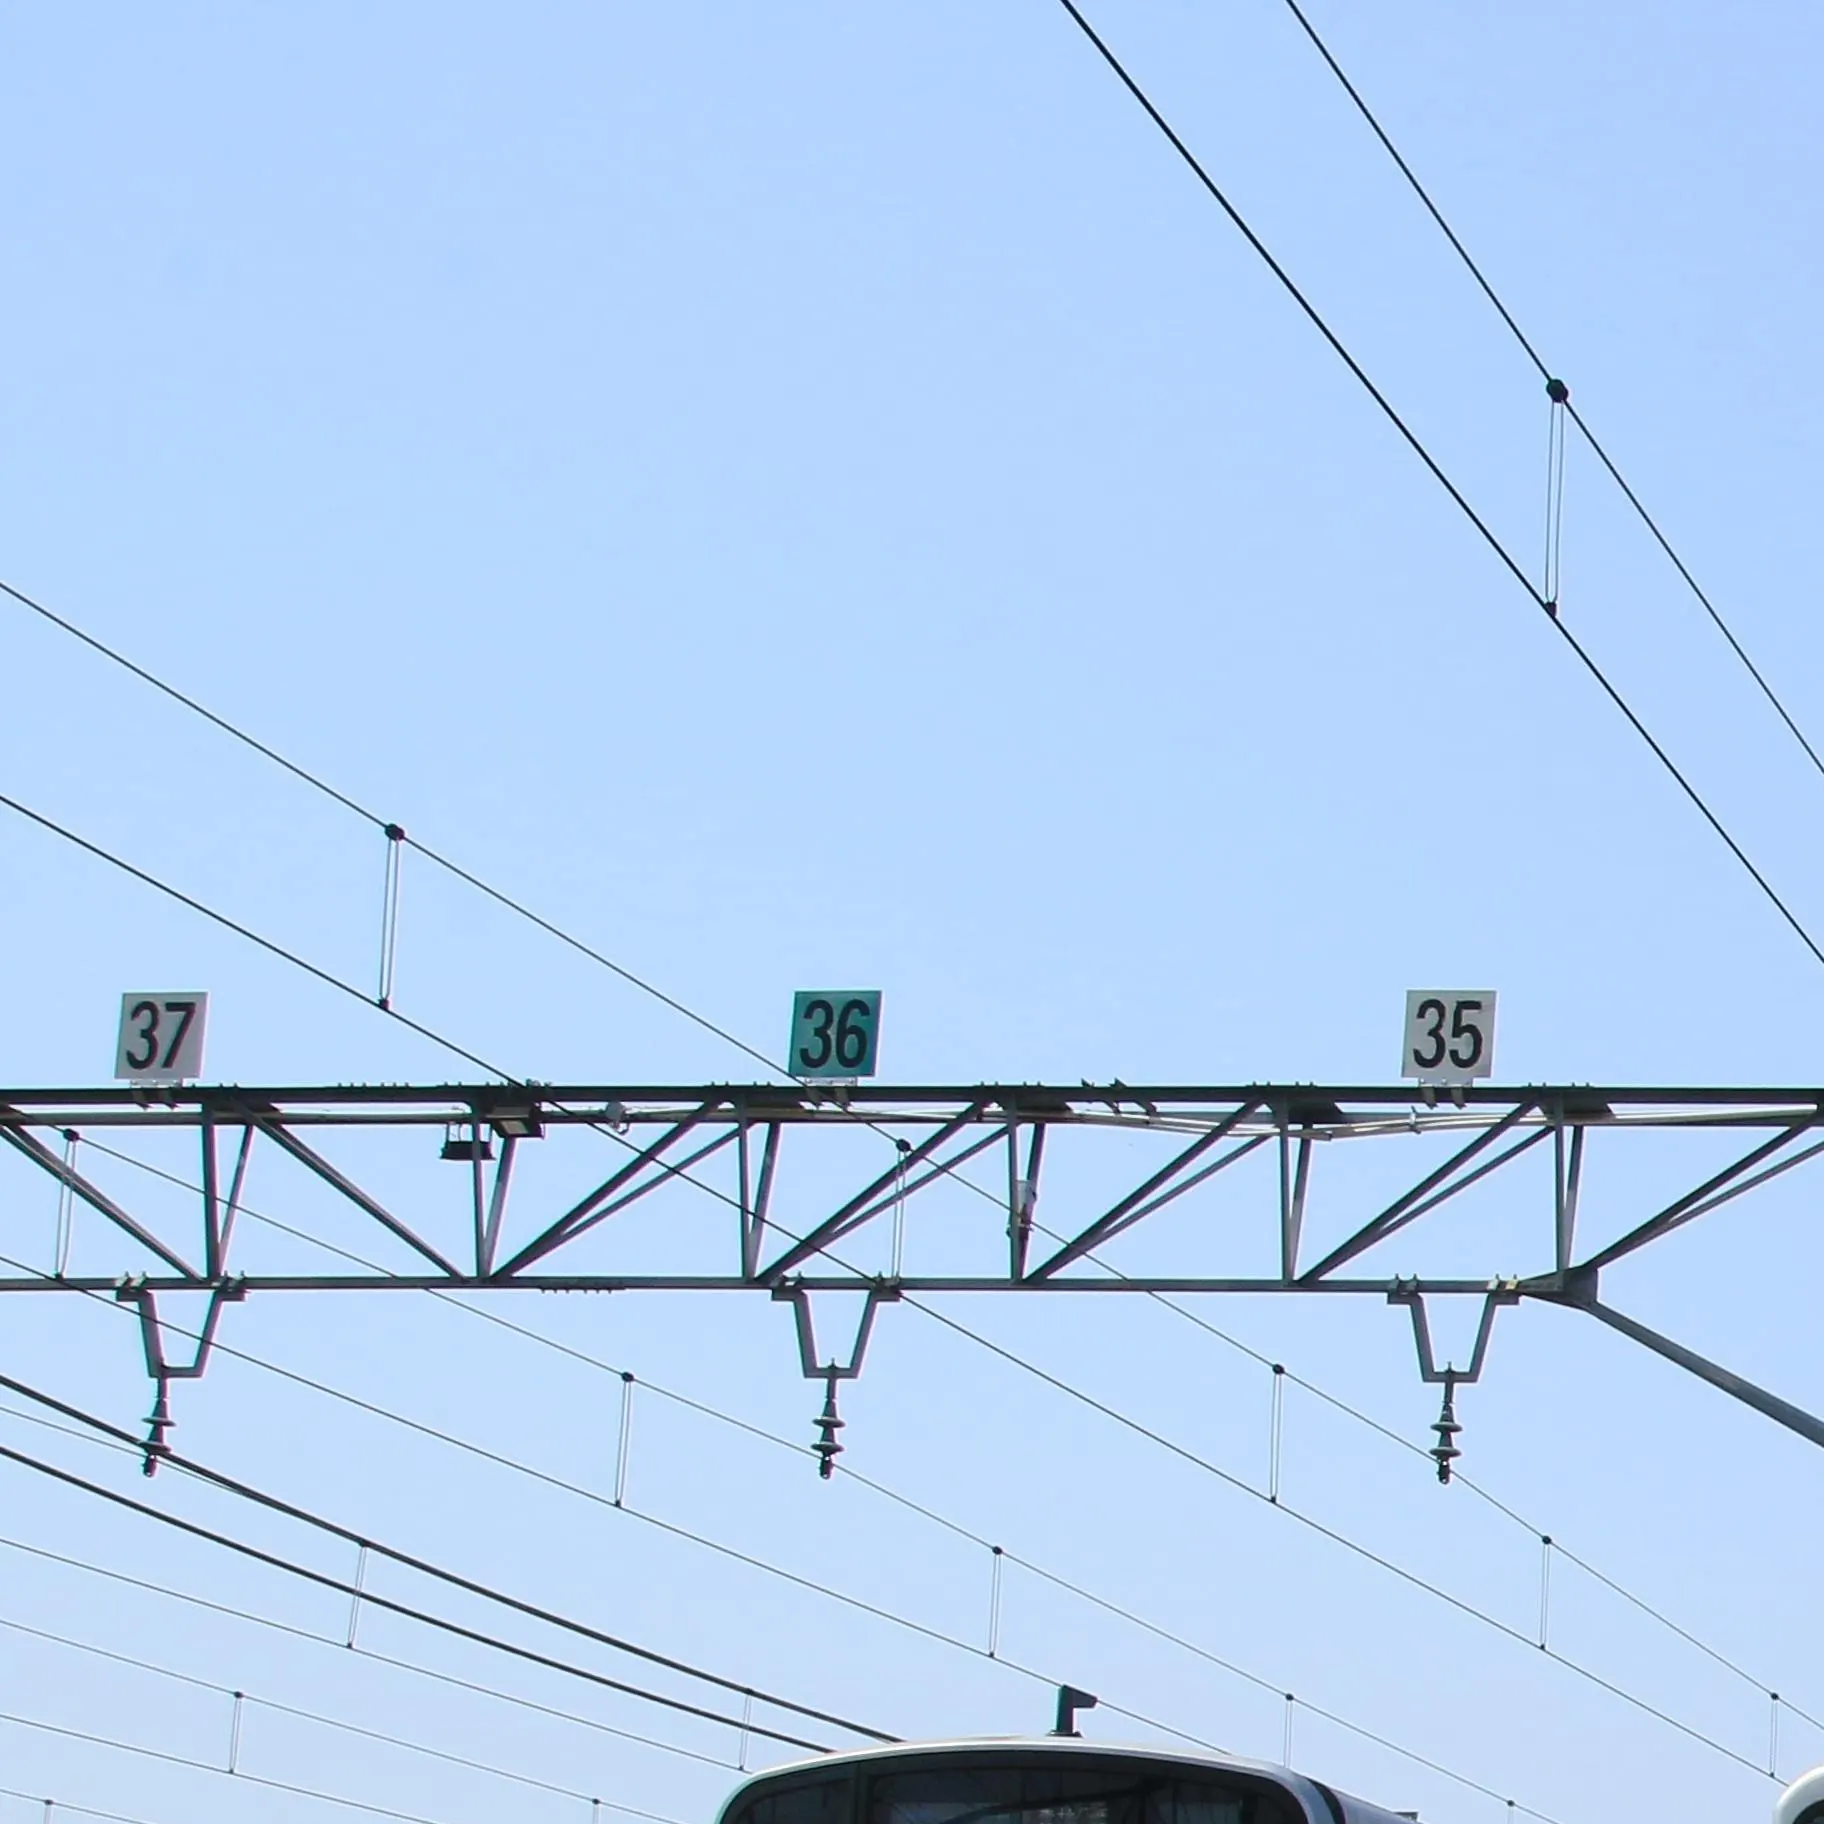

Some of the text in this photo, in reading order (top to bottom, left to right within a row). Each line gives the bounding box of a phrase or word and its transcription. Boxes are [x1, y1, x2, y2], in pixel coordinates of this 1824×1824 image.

[126, 1000, 196, 1069] 37
[800, 998, 871, 1068] 36
[1413, 998, 1482, 1068] 35
